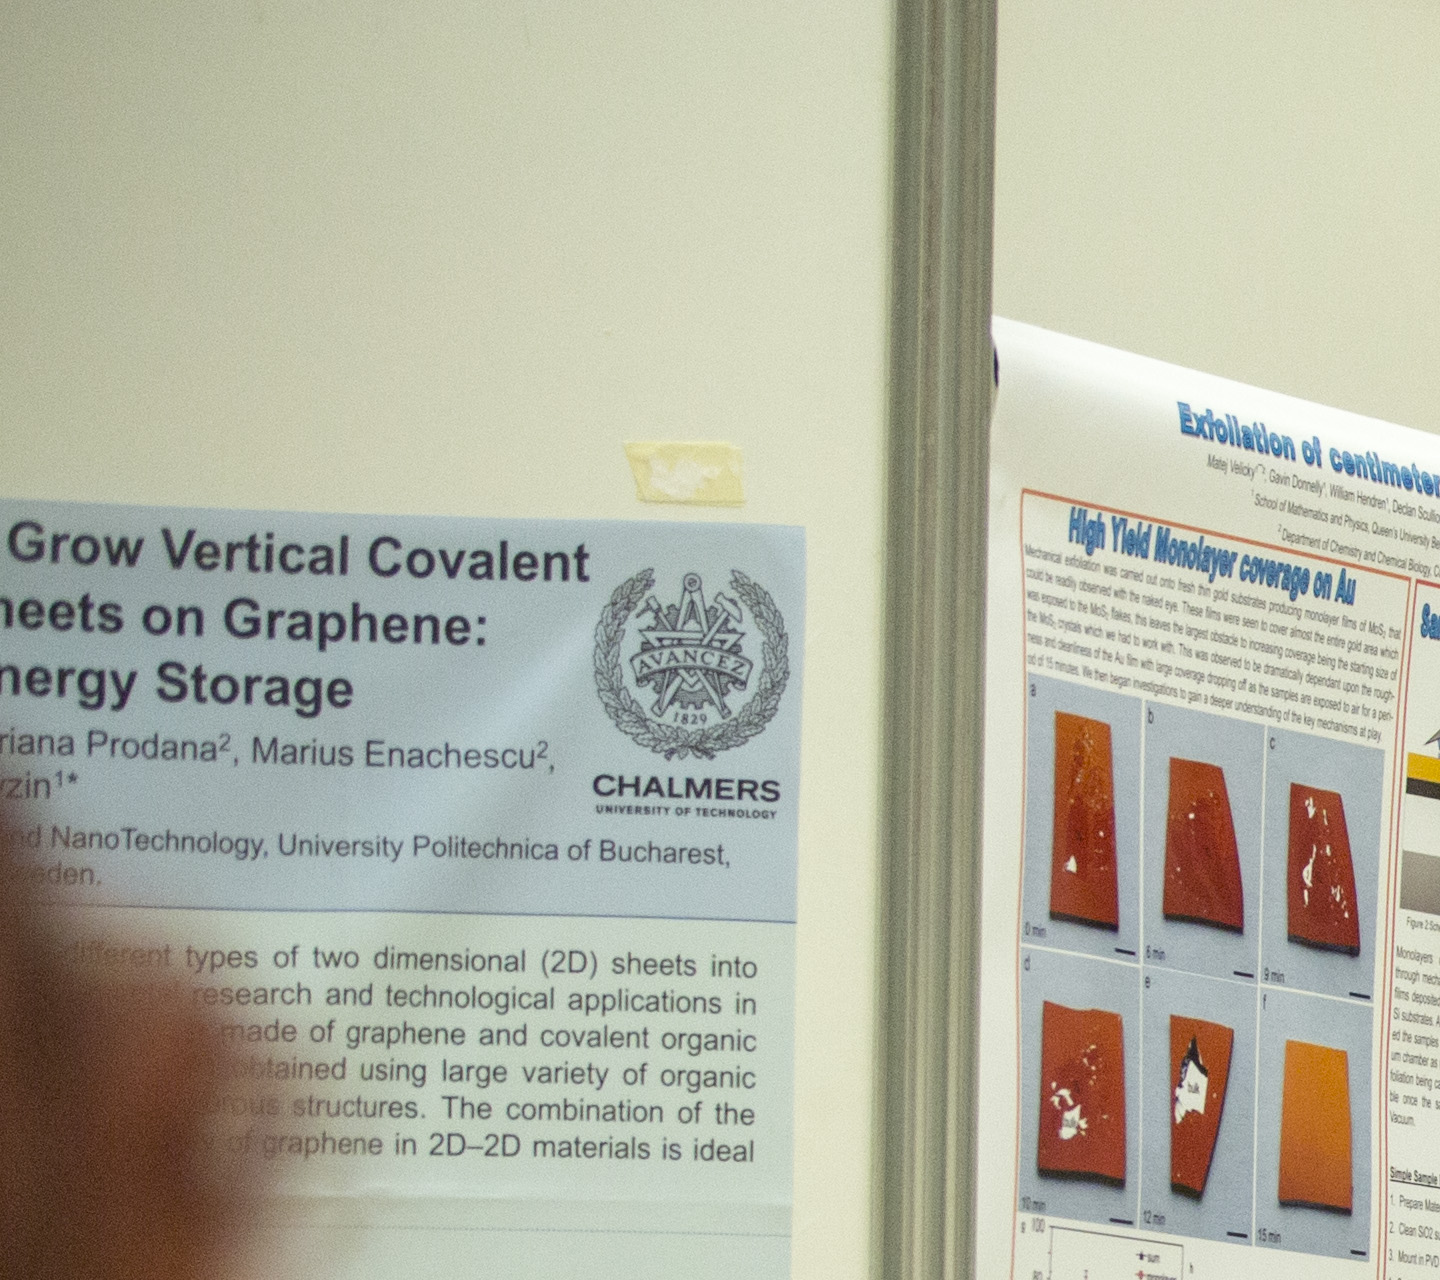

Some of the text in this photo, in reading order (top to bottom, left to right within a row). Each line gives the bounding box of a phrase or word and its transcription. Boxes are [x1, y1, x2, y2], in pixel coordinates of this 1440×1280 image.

[1177, 400, 1297, 461] Exfoliation
[1301, 434, 1322, 467] of
[1328, 446, 1440, 497] centimeter
[7, 519, 591, 583] Grow Vertical Covalent
[1068, 507, 1358, 606] High Yield Monolayer coverage on Au
[141, 603, 205, 637] on
[223, 596, 487, 650] Graphene:
[638, 650, 745, 676] AVANCEZ
[156, 659, 354, 719] Storage
[674, 711, 707, 725] 1829
[251, 735, 355, 768] Marius
[593, 774, 780, 802] CHALMERS
[596, 805, 777, 820] UNIVERSITY OF TECHNOLOGY
[51, 825, 731, 869] NanoTechnology, University Politechnica of Bucharest,
[186, 943, 259, 973] types
[272, 944, 300, 970] of
[312, 946, 360, 970] two
[372, 944, 527, 973] dimensional
[540, 948, 599, 980] (2D)
[611, 951, 698, 977] sheets
[710, 953, 759, 979] into
[324, 982, 374, 1007] and
[385, 983, 556, 1015] technological
[567, 986, 723, 1017] applications
[735, 990, 757, 1015] in
[221, 1017, 758, 1058] made of graphene and covalent organic
[359, 1057, 428, 1088] using
[441, 1058, 509, 1089] large
[521, 1060, 610, 1092] variety
[621, 1060, 649, 1086] of
[659, 1064, 757, 1095] organic
[293, 1095, 426, 1120] structures.
[440, 1094, 493, 1120] The
[505, 1096, 665, 1124] combination
[677, 1099, 704, 1124] of
[714, 1100, 756, 1126] the
[263, 1131, 384, 1158] graphene
[394, 1131, 418, 1155] in
[532, 1134, 652, 1160] materials
[661, 1136, 683, 1162] is
[693, 1136, 755, 1163] ideal
